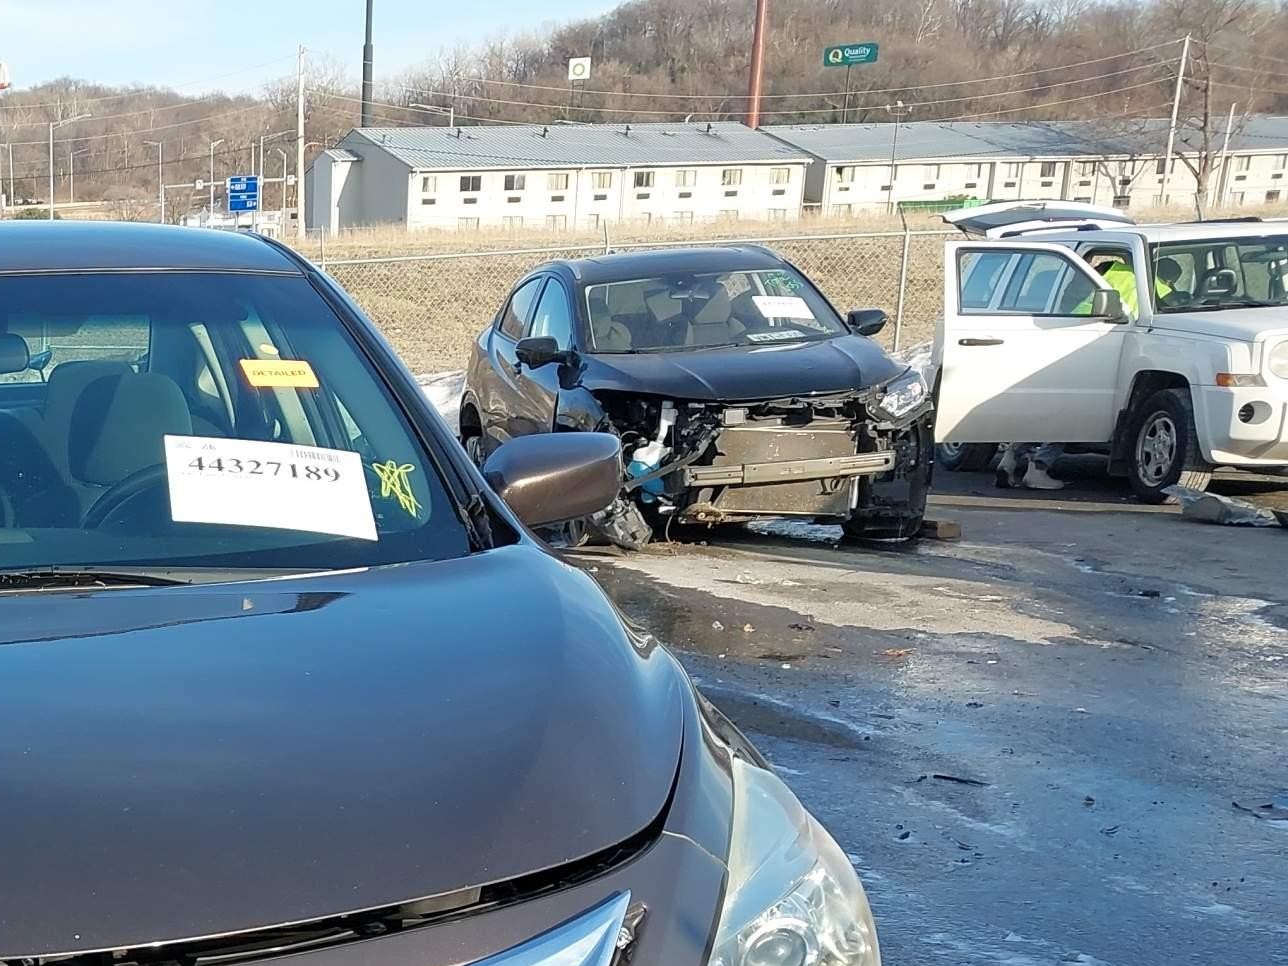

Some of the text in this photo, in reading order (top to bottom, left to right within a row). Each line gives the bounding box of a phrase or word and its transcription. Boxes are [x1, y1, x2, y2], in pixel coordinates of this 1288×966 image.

[844, 46, 871, 57] Quality
[252, 369, 306, 377] DETAILED
[188, 456, 342, 482] 44327189
